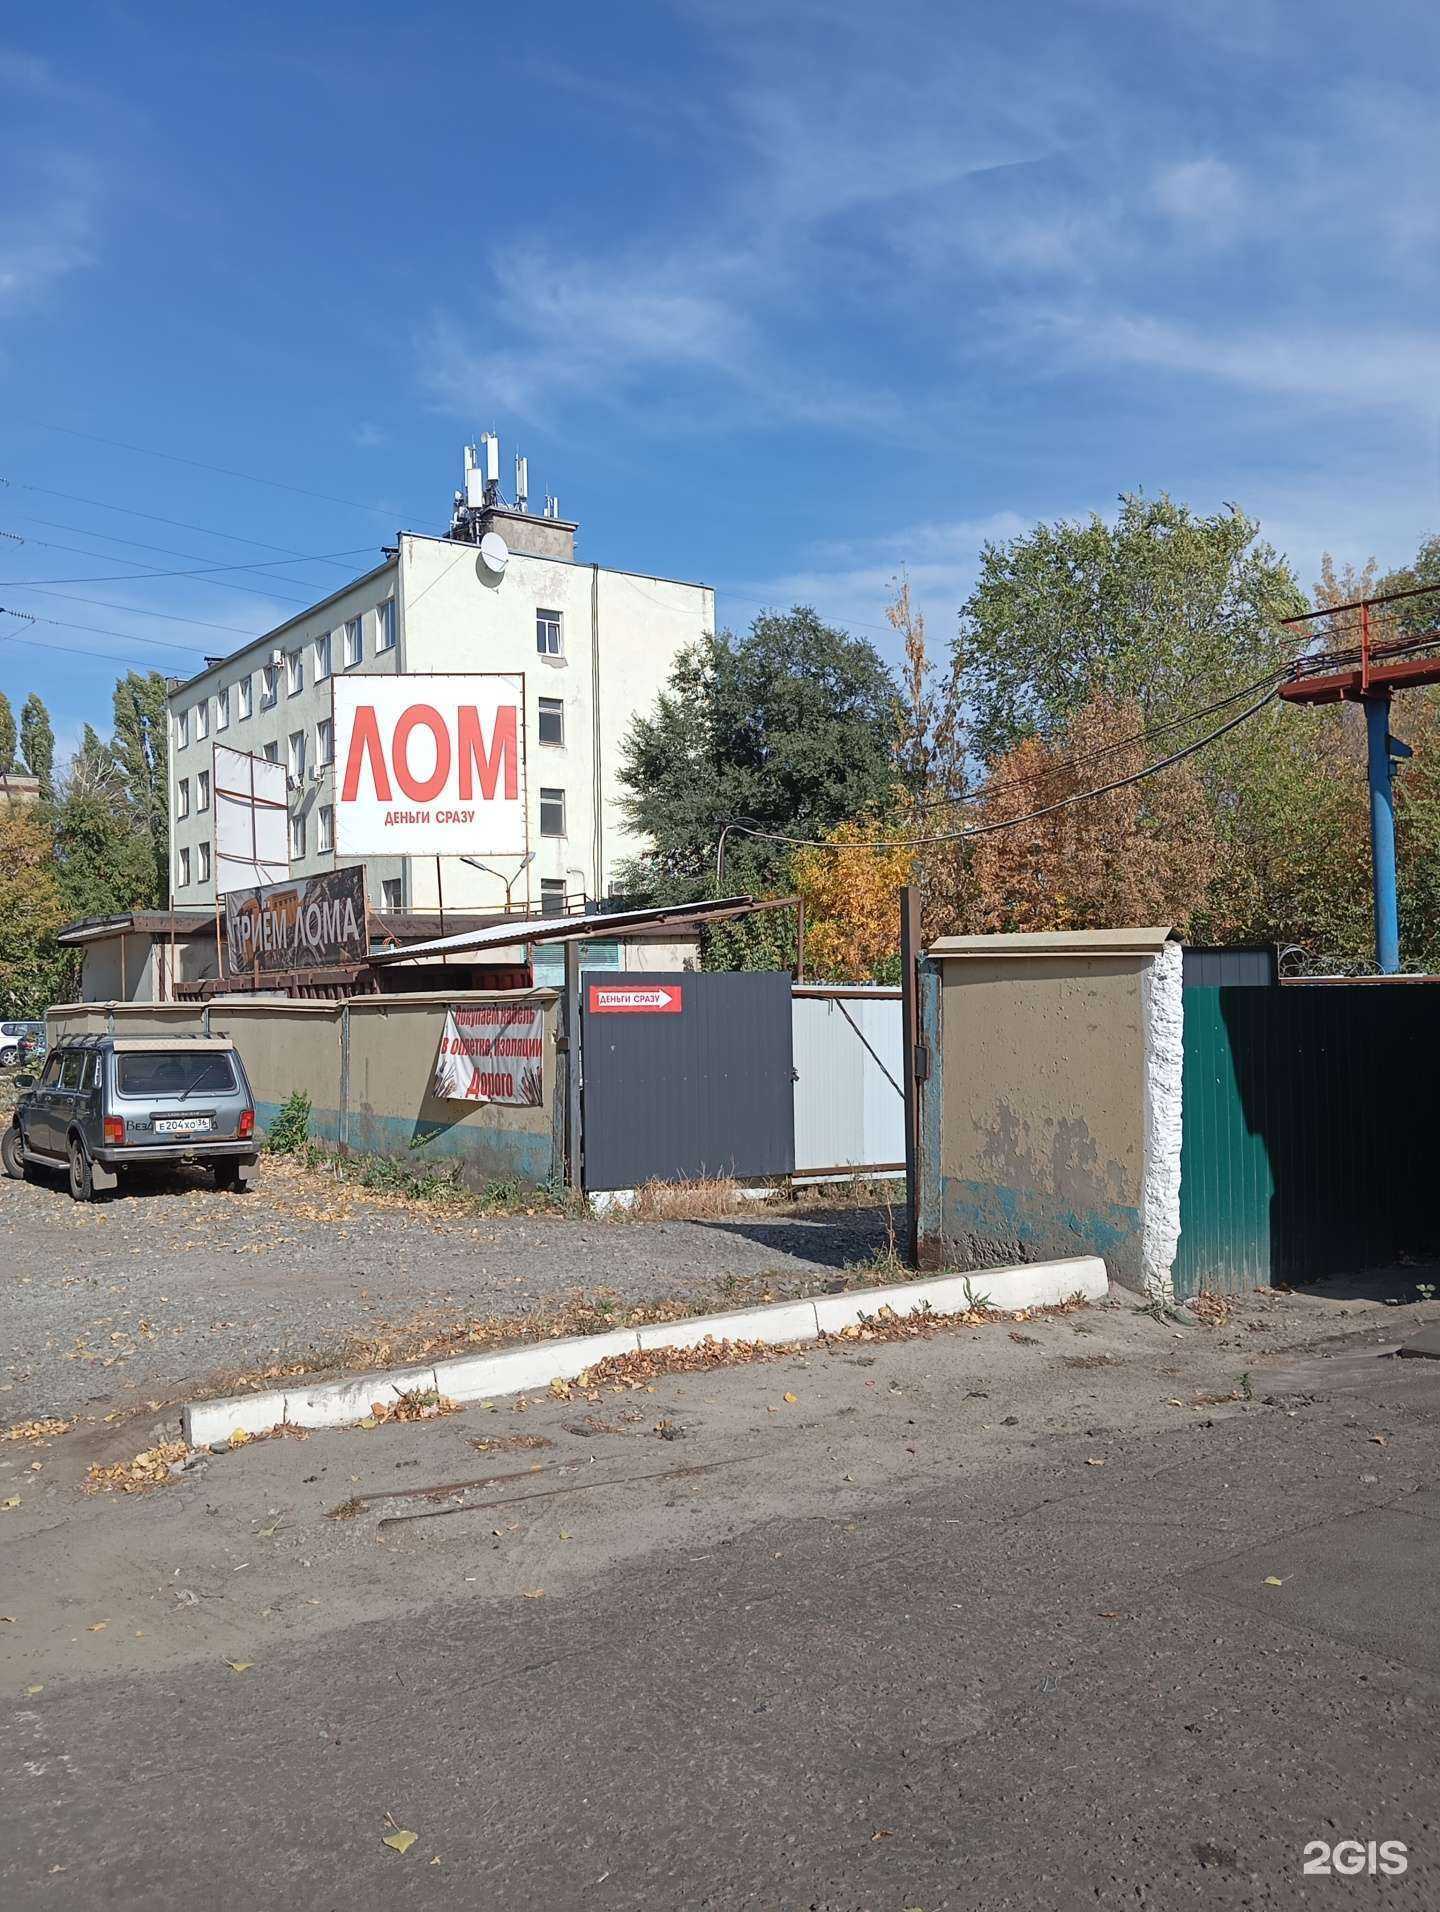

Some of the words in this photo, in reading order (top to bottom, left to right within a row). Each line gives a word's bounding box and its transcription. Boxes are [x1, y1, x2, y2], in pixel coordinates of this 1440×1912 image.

[341, 703, 518, 803] ЛОМ
[384, 811, 430, 827] ДЕНЬГИ
[435, 810, 476, 824] СРАЗУ
[231, 899, 288, 954] ПРИЁМ
[293, 897, 360, 950] ЛОМА
[599, 995, 631, 1004] ДЕНЬГИ
[633, 995, 660, 1003] СРАЗУ
[500, 1003, 536, 1025] кабель
[465, 1067, 513, 1099] Дорого
